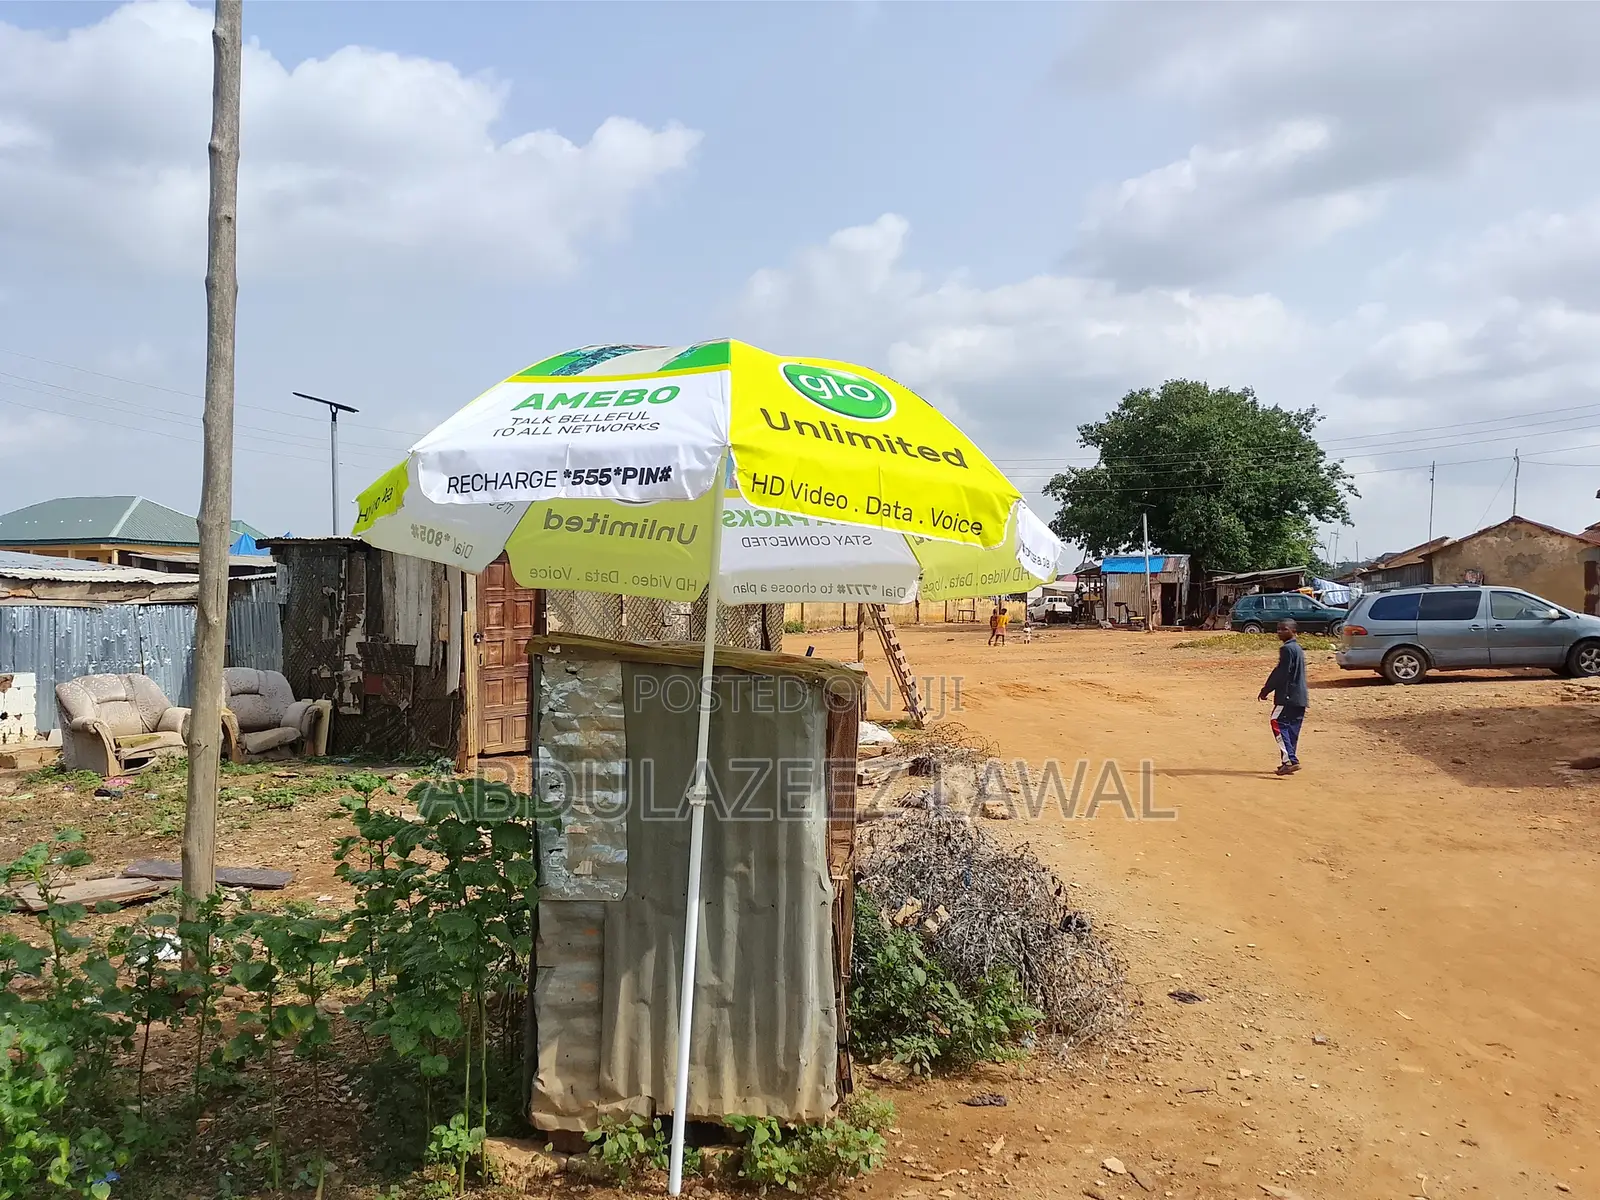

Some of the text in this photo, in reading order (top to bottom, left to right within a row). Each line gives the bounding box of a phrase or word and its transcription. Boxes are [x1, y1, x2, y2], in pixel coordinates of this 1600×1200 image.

[510, 385, 681, 411] AMEBO
[799, 373, 876, 400] glo
[492, 422, 660, 437] TO ALL NETWORKS
[511, 411, 650, 427] TALK BELLEFUL
[760, 408, 969, 469] Unlimited
[446, 470, 558, 494] RECHARGE
[751, 472, 983, 536] HD Video Data Voice
